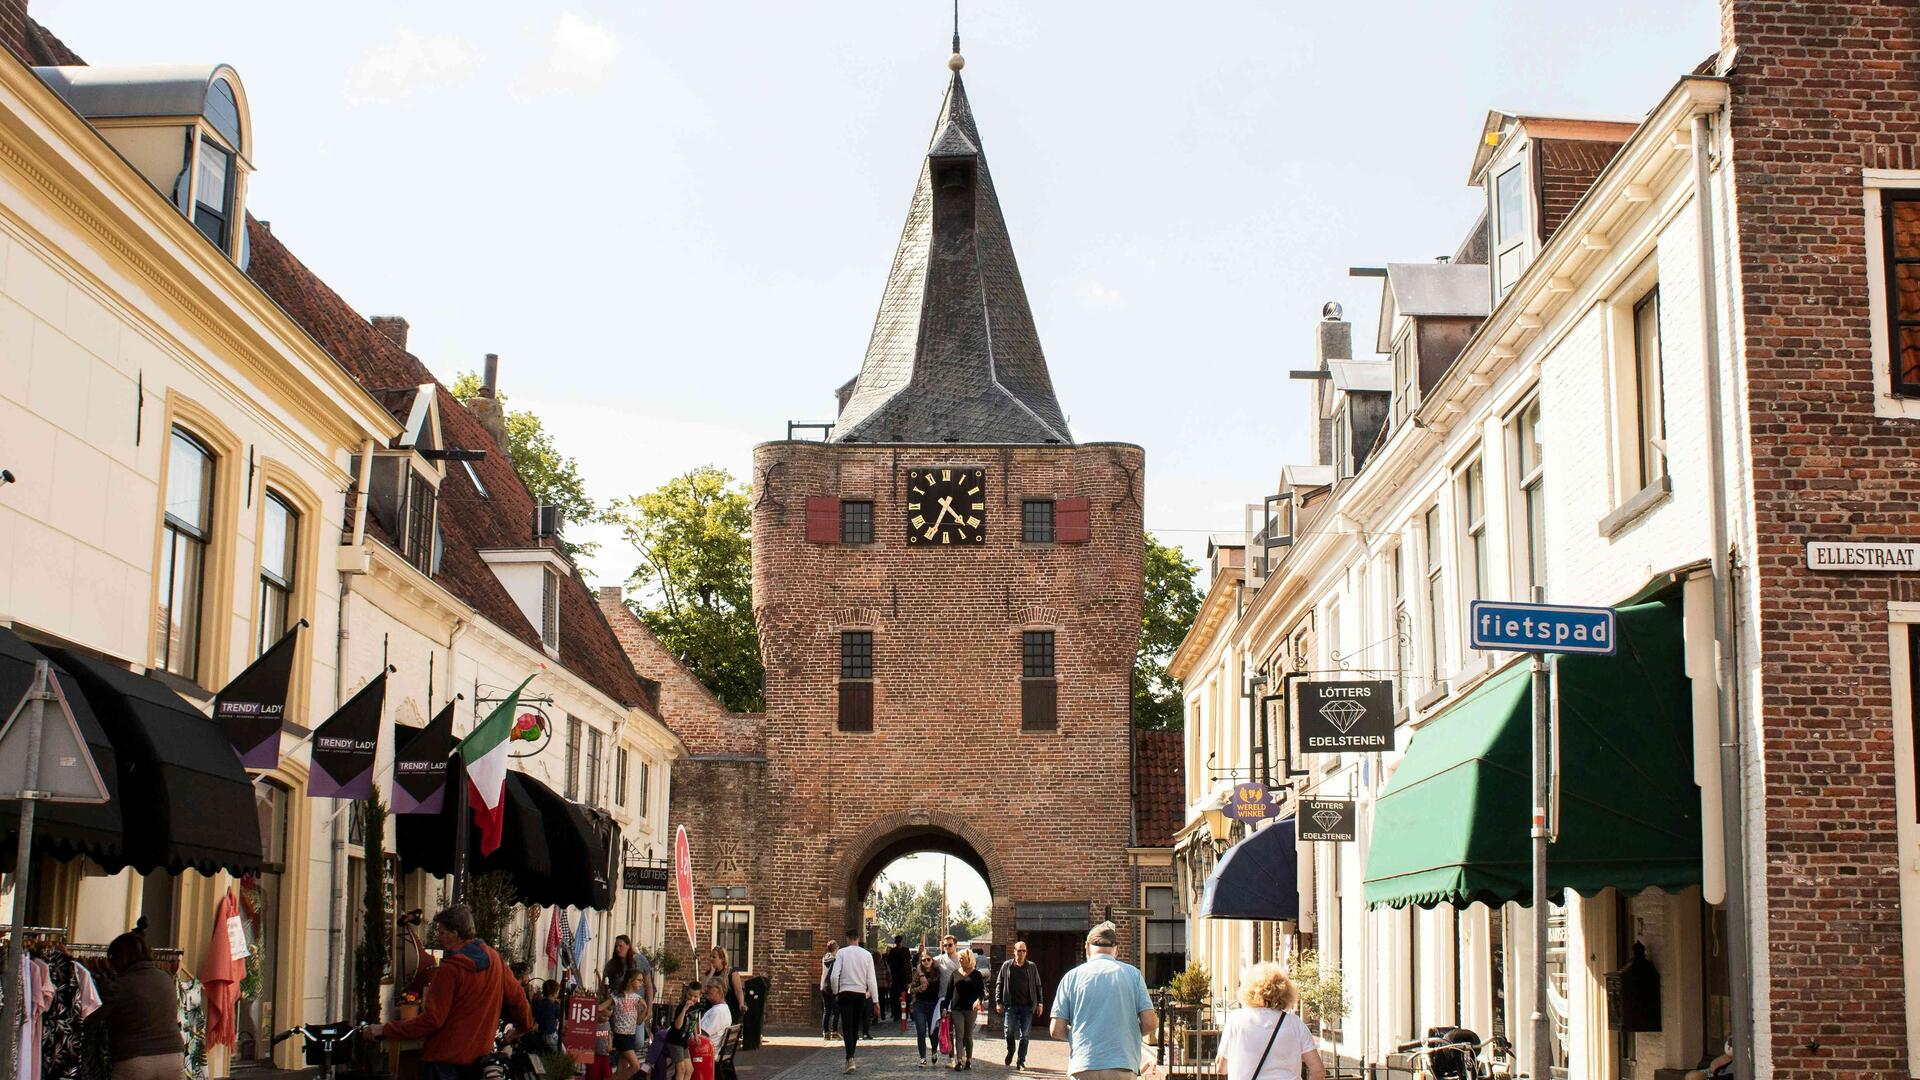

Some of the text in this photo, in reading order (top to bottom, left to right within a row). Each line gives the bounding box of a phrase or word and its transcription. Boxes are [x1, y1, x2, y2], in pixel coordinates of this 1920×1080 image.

[1816, 547, 1915, 567] ELLESTRAAT
[1480, 614, 1607, 645] fietspad
[1319, 686, 1372, 698] LÖTTERS
[222, 703, 284, 713] TRENDY LADY
[319, 738, 376, 749] TRENDY LADY
[1309, 735, 1385, 746] EDELSTENEN
[400, 761, 448, 770] TRENDY LADY
[1236, 803, 1267, 811] WERELD
[1303, 832, 1351, 840] EDELSTENEN
[571, 1003, 597, 1024] ijs!
